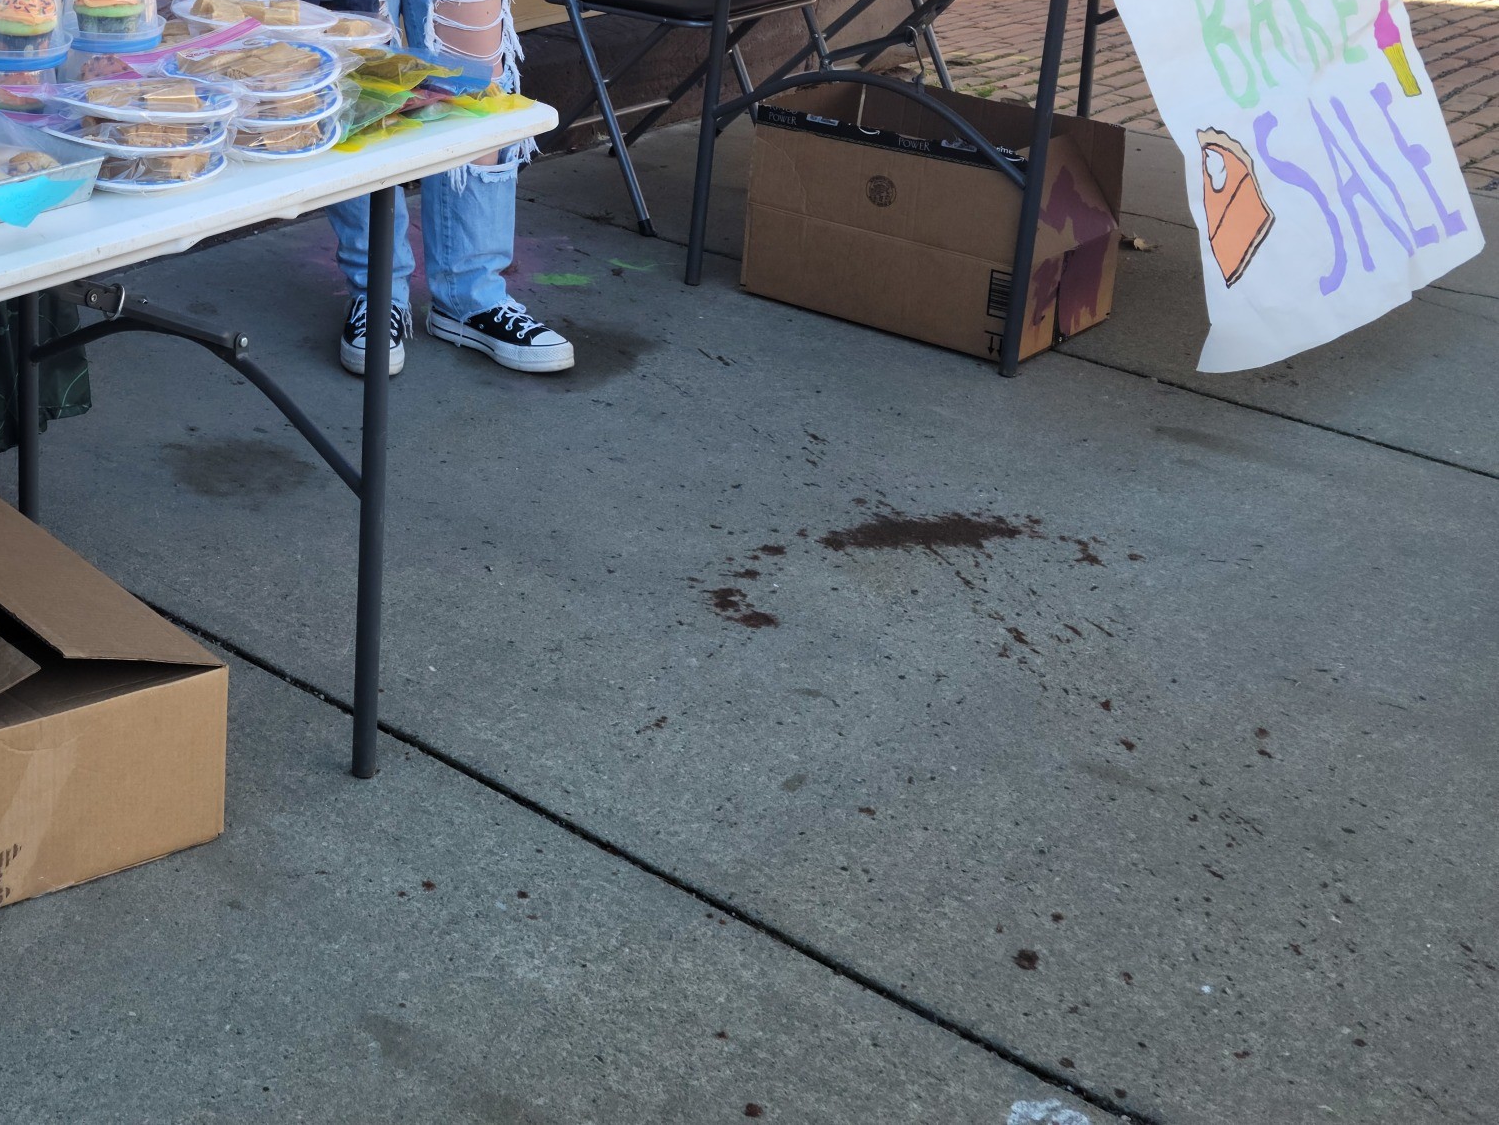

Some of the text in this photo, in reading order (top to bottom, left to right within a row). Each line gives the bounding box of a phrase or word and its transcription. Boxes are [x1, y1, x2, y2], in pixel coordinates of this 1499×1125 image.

[768, 111, 797, 126] POWER
[897, 136, 931, 152] POWER
[1253, 81, 1468, 297] SALE
